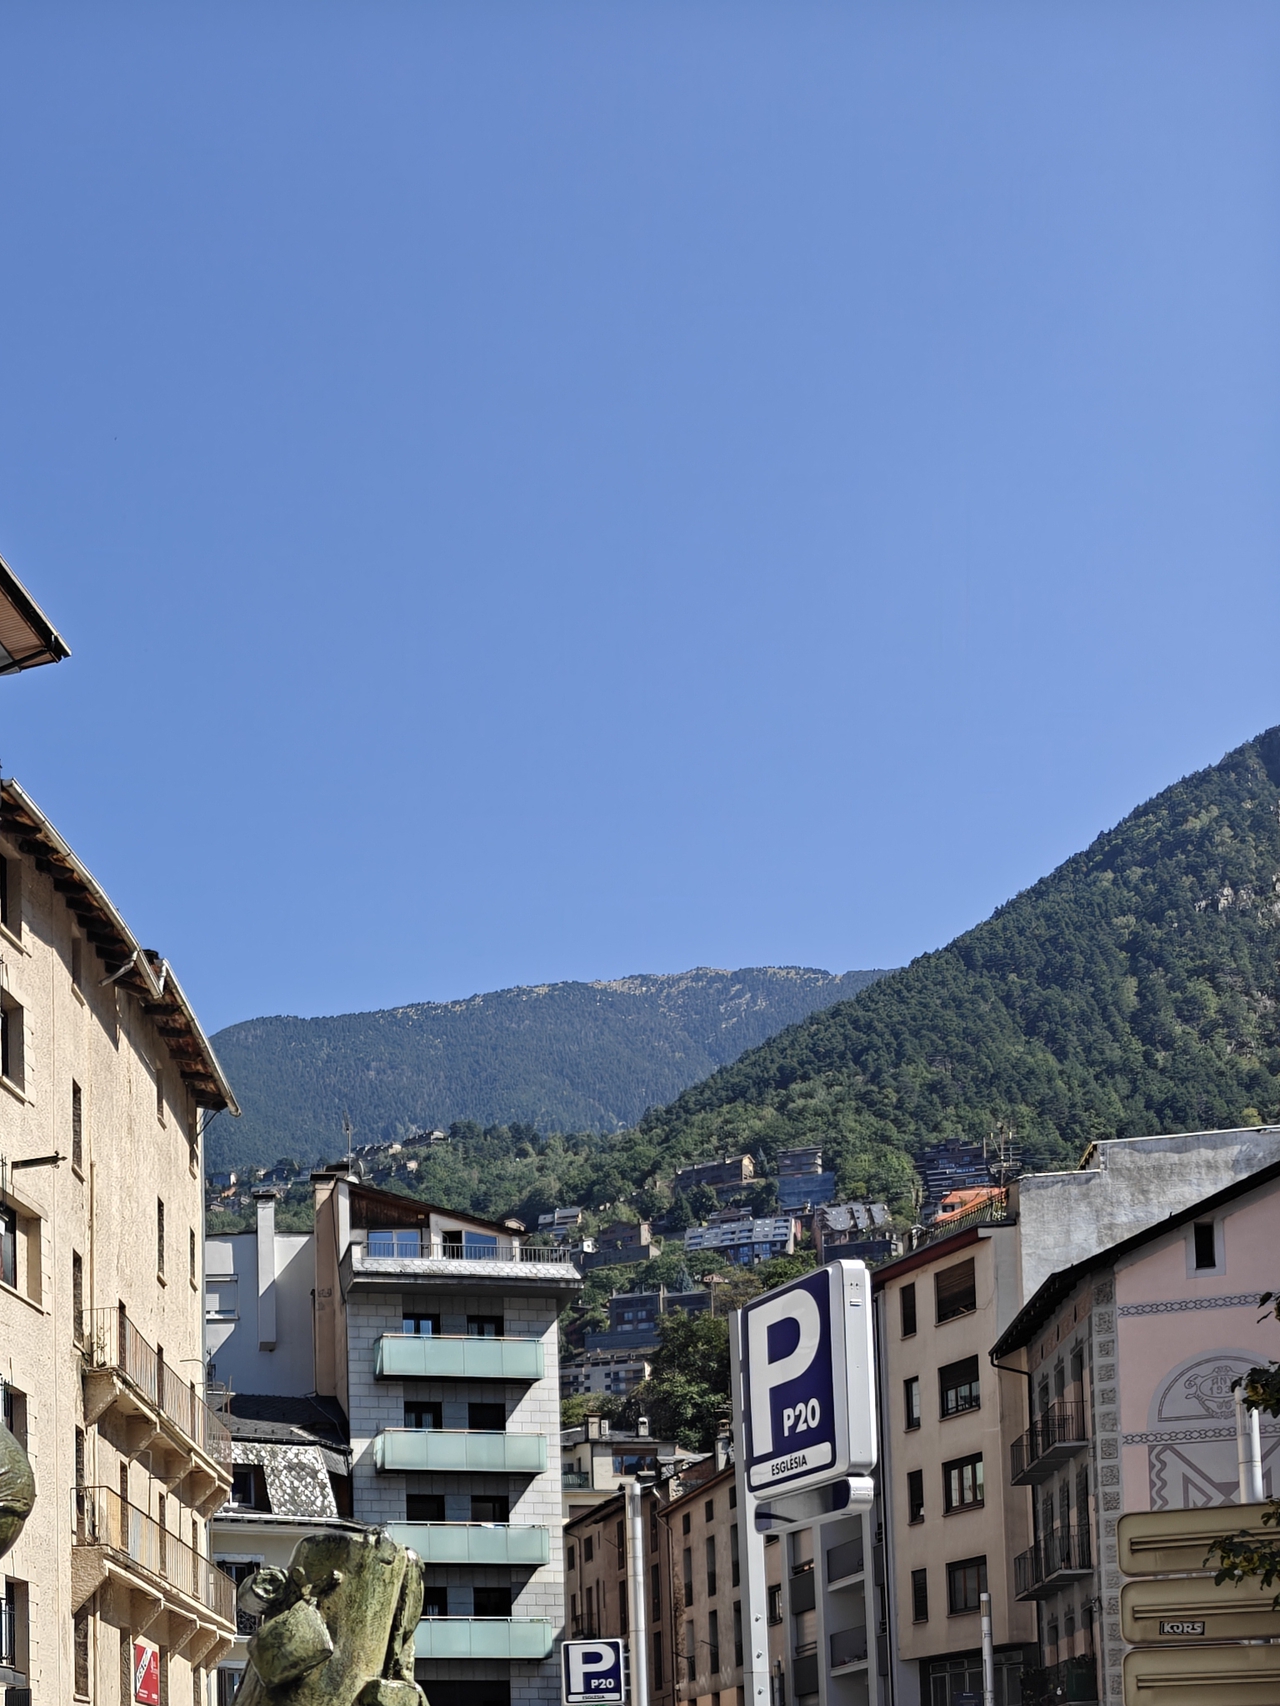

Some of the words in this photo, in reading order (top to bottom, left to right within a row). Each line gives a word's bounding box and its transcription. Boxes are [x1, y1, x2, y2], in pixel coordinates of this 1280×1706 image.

[747, 1288, 821, 1458] P
[782, 1397, 821, 1437] P20
[771, 1453, 808, 1477] ESGLÉSIA
[568, 1643, 616, 1693] P
[590, 1678, 615, 1689] P20
